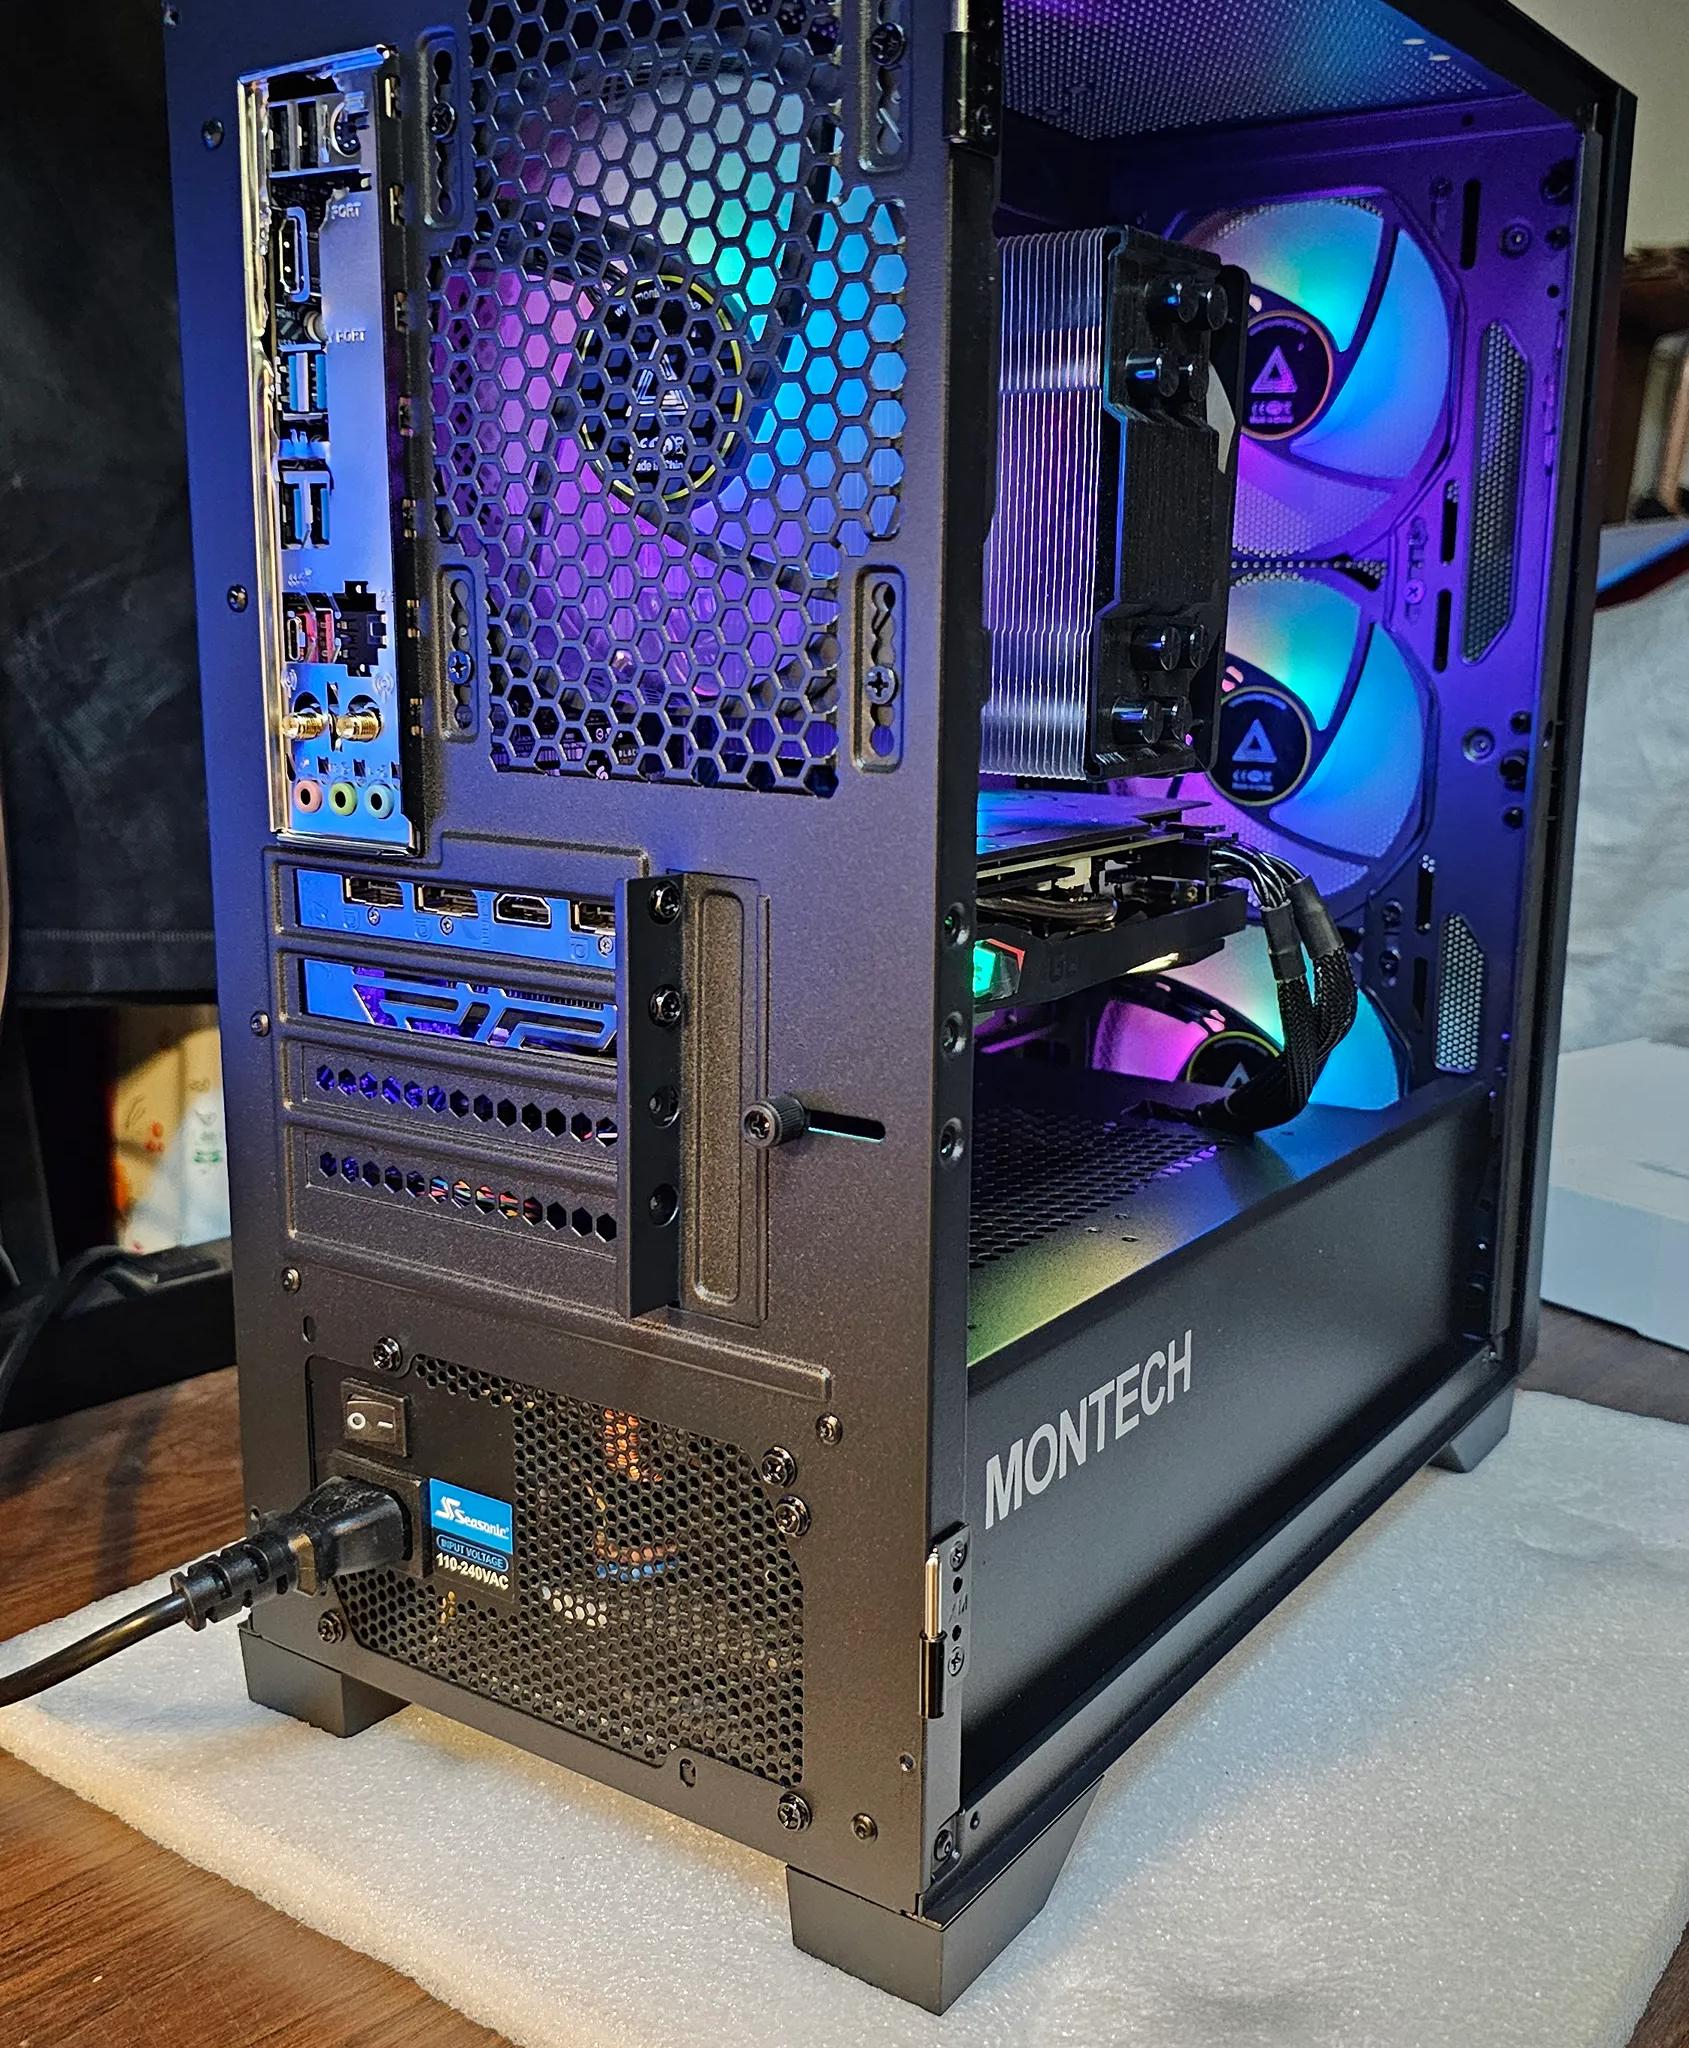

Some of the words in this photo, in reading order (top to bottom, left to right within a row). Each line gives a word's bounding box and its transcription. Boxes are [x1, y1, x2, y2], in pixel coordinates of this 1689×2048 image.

[985, 1329, 1192, 1530] MONTECH
[453, 1509, 508, 1539] Seasonic
[441, 1538, 464, 1555] INPUT
[466, 1547, 504, 1569] VOLTAGE
[436, 1552, 509, 1590] 110-240VAC
